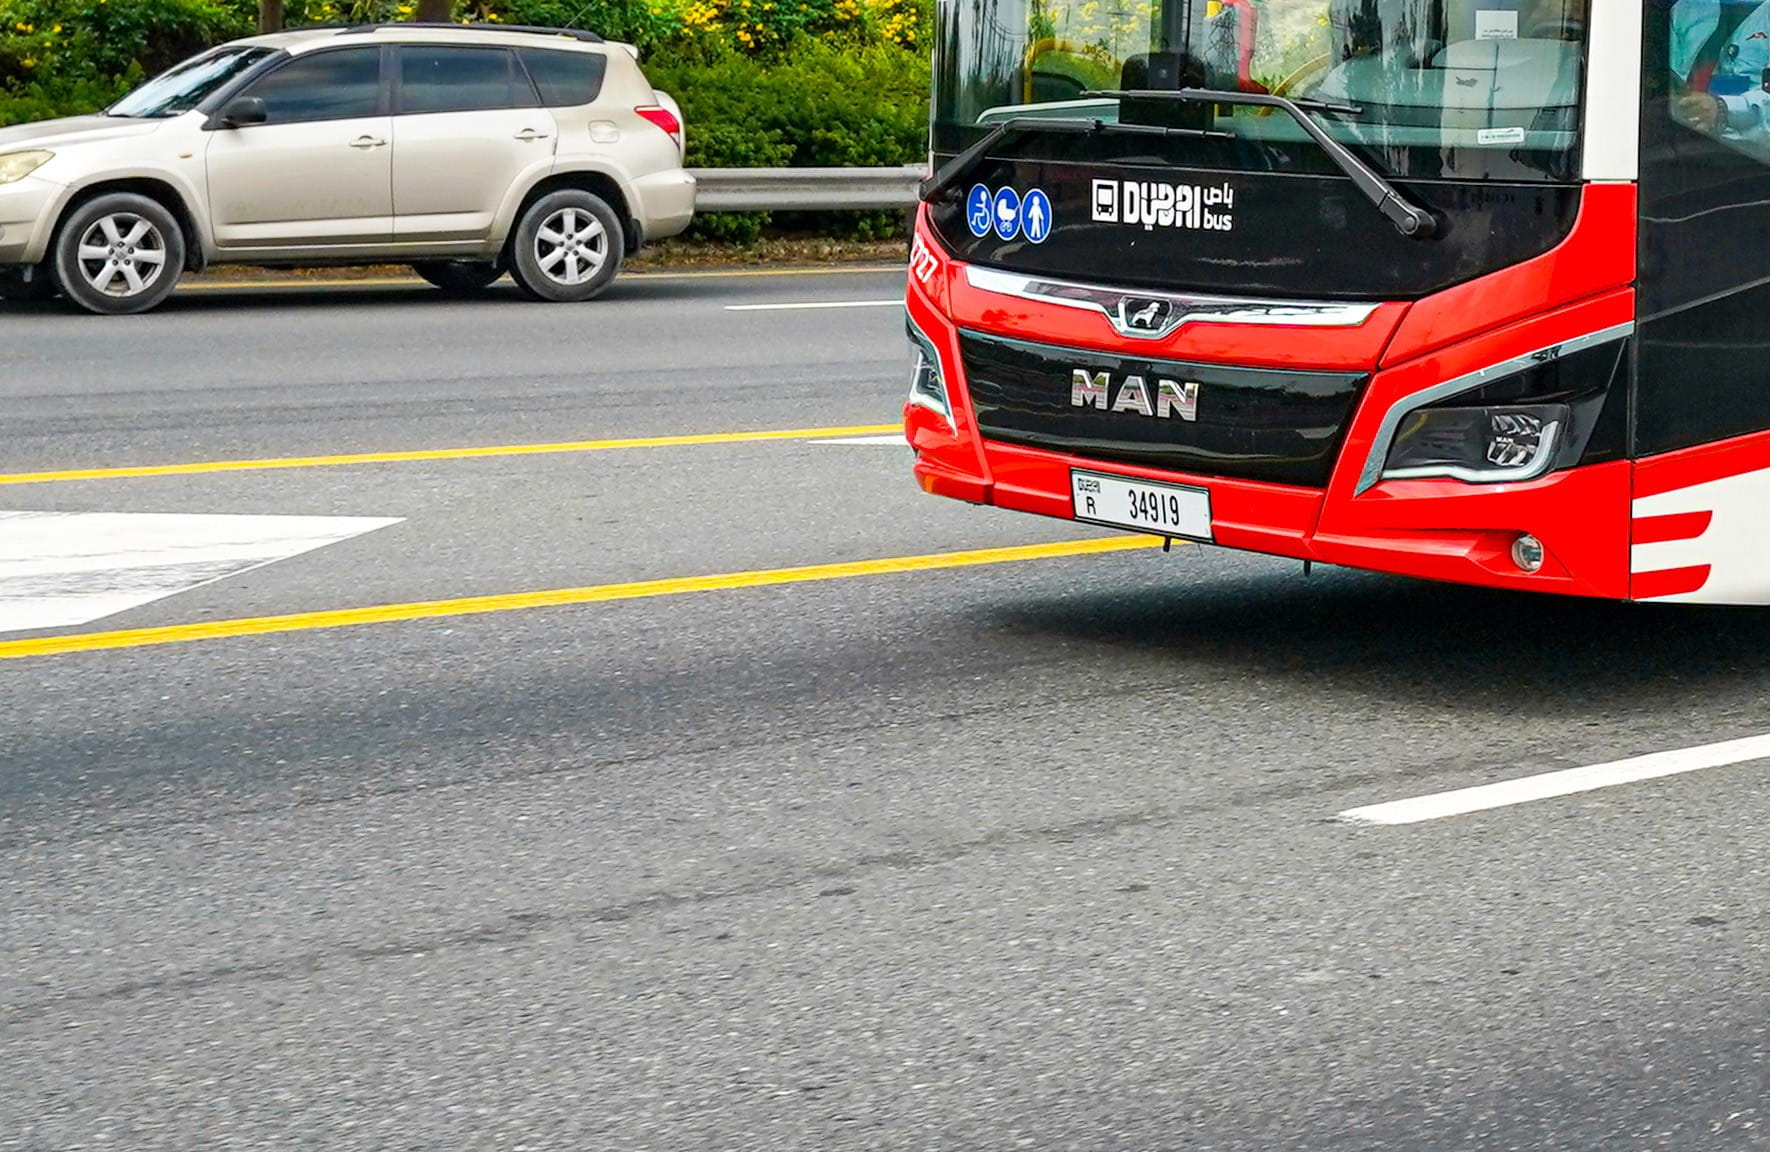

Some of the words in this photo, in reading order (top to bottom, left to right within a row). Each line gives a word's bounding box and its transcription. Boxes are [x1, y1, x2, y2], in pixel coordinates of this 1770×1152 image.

[1123, 180, 1201, 231] DUBAI
[1202, 182, 1234, 209] باص
[1202, 207, 1233, 231] bus
[1071, 368, 1200, 422] MAN
[1086, 495, 1097, 516] R
[1128, 489, 1180, 527] 34919
